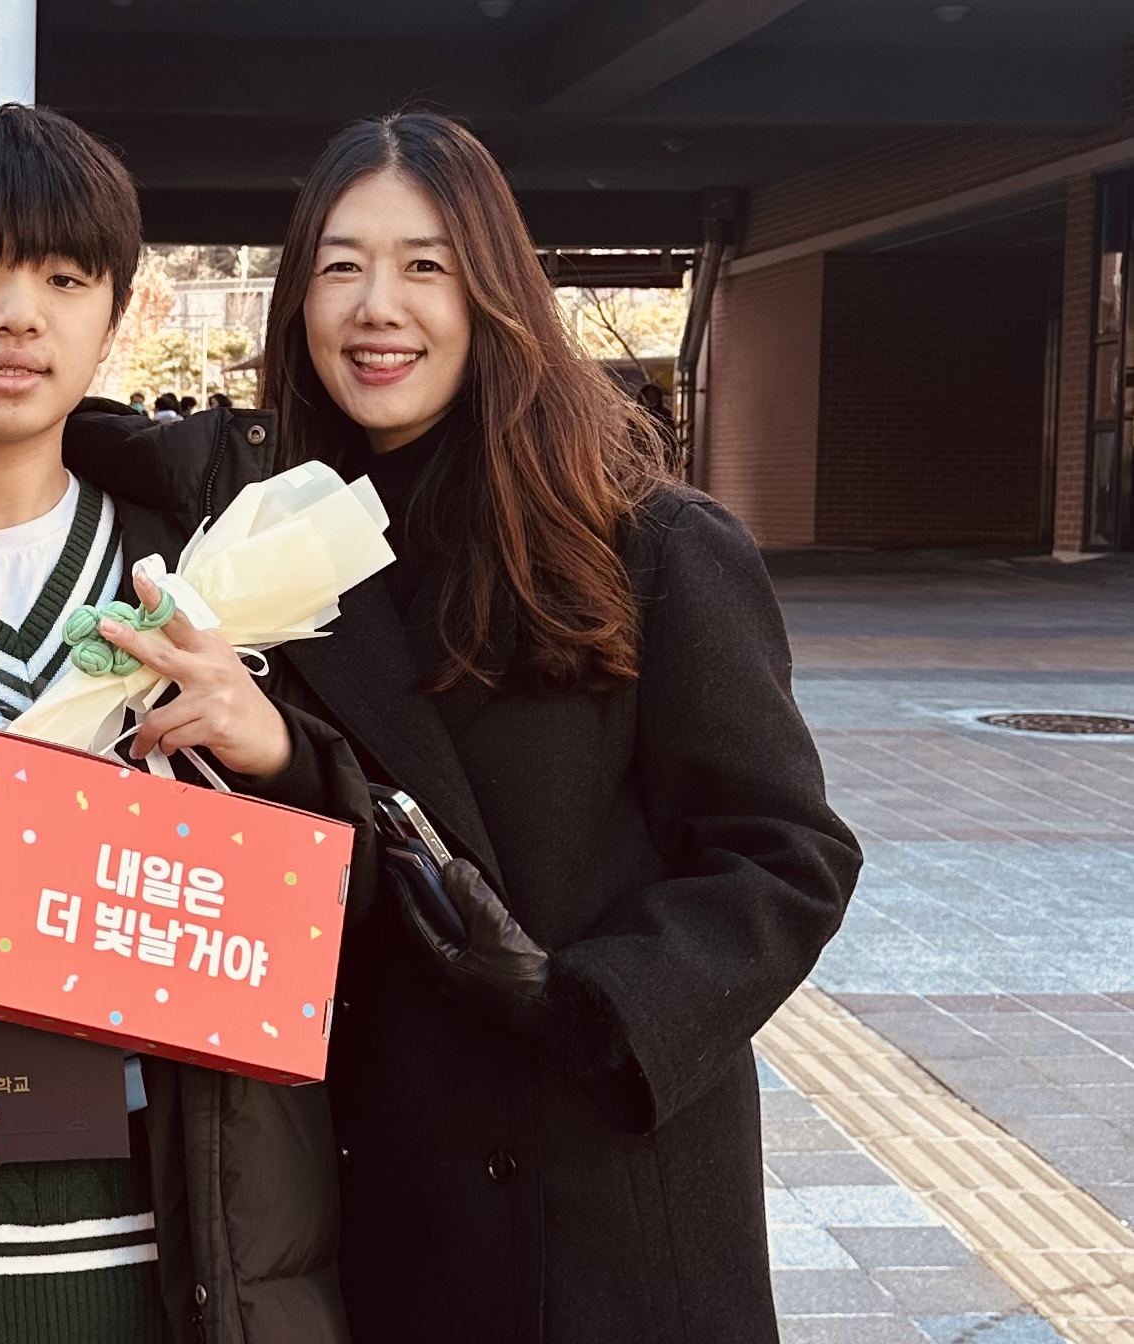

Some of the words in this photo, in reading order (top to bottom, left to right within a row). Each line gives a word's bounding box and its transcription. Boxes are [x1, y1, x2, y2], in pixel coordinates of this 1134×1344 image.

[95, 843, 225, 919] 내일은
[36, 887, 82, 944] 더
[93, 901, 269, 988] 빛날거야
